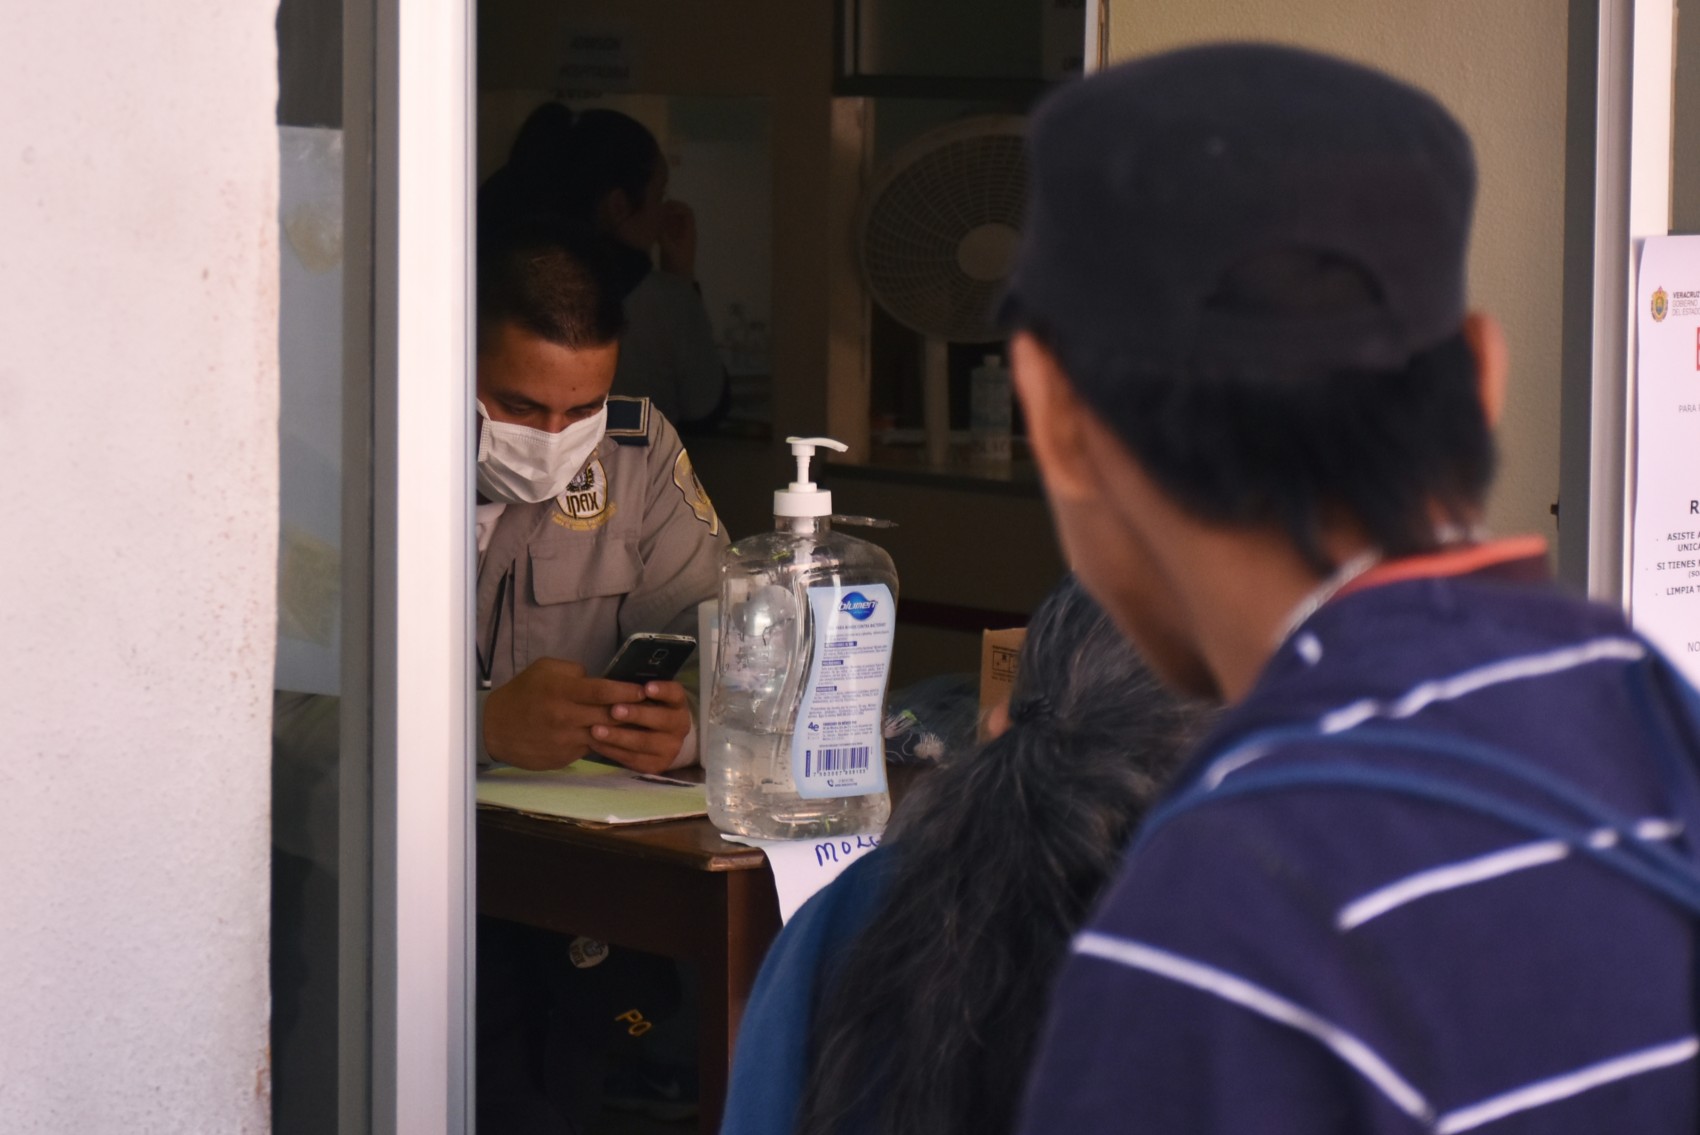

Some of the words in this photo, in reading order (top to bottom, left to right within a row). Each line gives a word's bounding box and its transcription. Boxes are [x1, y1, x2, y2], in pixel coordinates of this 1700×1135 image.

[1679, 404, 1697, 413] PARA
[1667, 531, 1695, 541] ASISTE
[1656, 562, 1666, 571] SI
[1668, 560, 1696, 570] TIENES
[1666, 585, 1695, 596] LIMPIA
[807, 721, 820, 732] 4e
